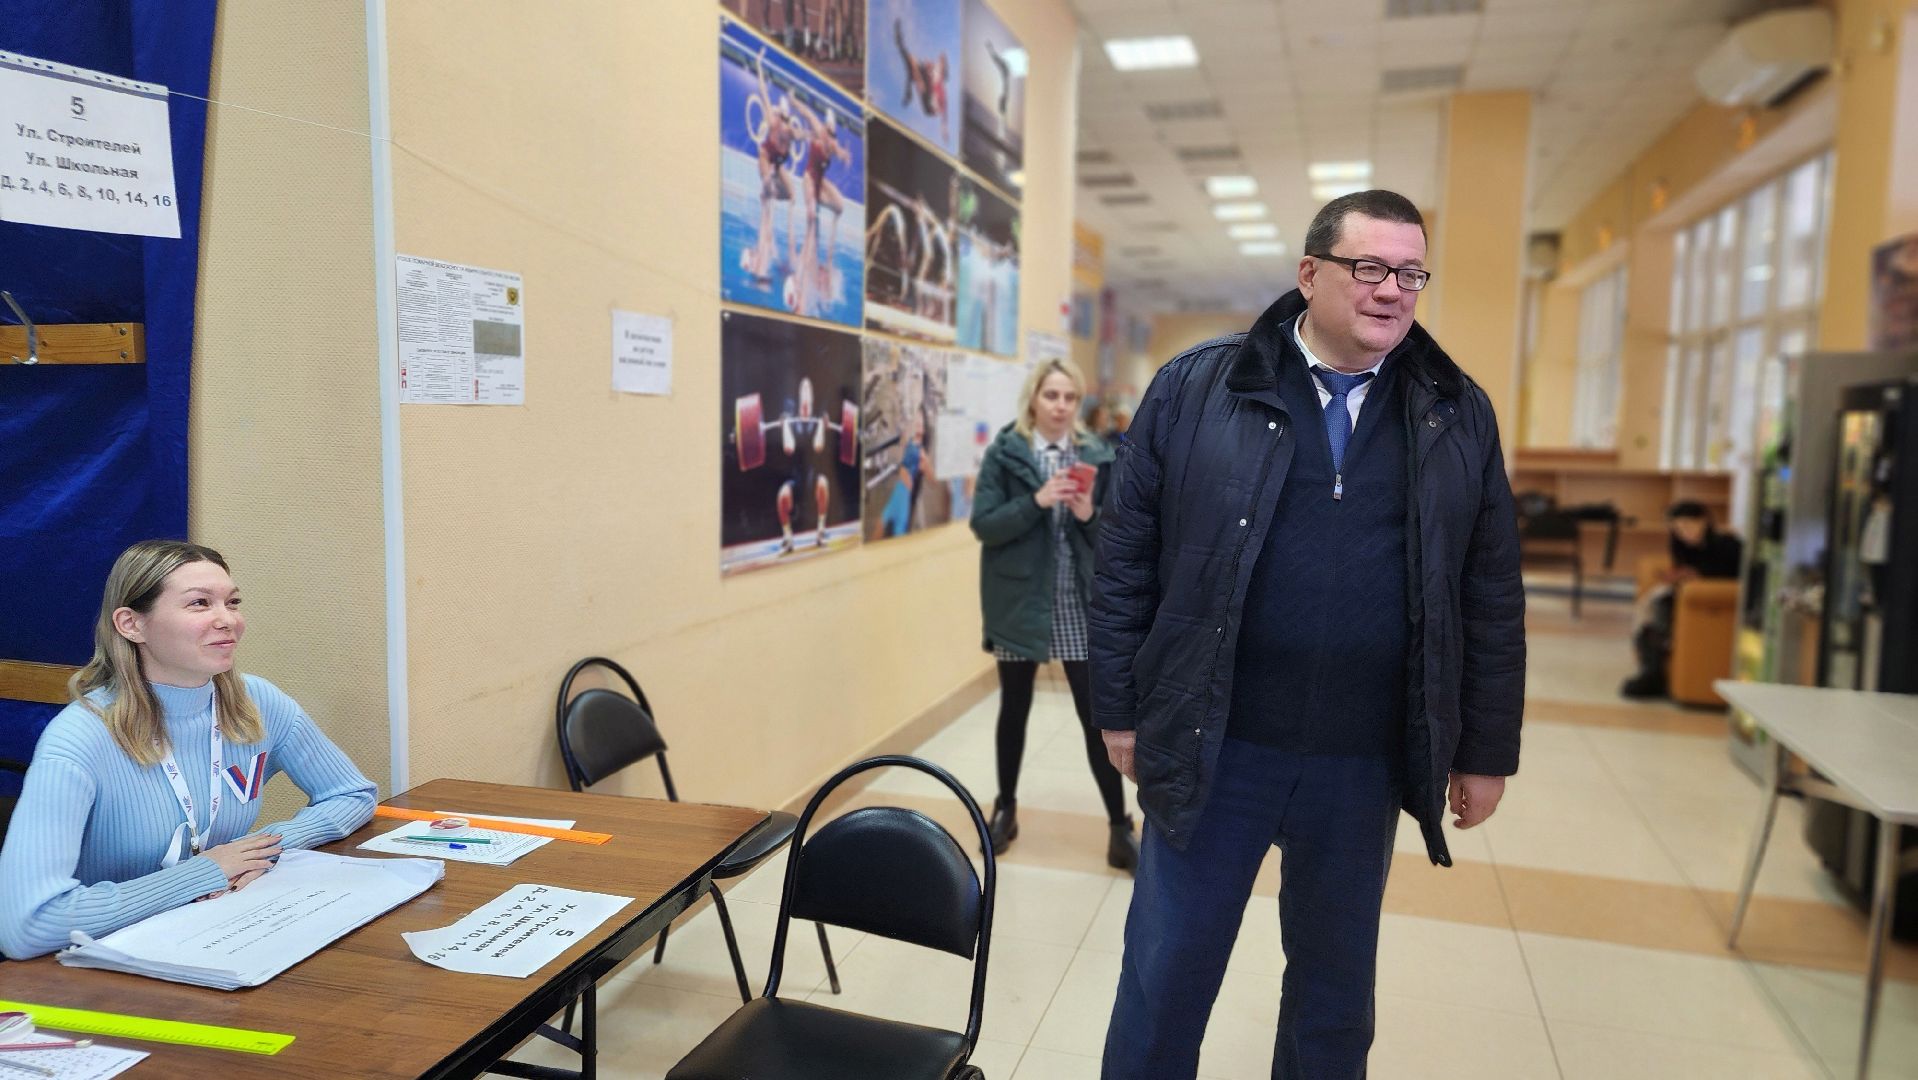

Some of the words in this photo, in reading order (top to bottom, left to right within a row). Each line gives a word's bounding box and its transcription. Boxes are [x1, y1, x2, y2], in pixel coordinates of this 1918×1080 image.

[71, 95, 86, 116] 5
[15, 122, 42, 140] Ул.
[46, 128, 142, 155] Строителей
[25, 151, 50, 167] Ул.
[55, 155, 139, 179] Школьная
[20, 177, 36, 192] 2,
[39, 180, 53, 197] 4,
[57, 182, 73, 199] 6,
[77, 185, 92, 201] 8,
[96, 187, 121, 204] 10,
[125, 191, 148, 207] 14,
[152, 194, 172, 207] 16
[518, 895, 537, 903] 2,
[494, 911, 512, 919] 6,
[529, 903, 553, 915] Ул.
[554, 903, 578, 915] Ул.
[462, 928, 487, 940] 10,
[472, 915, 535, 953] Школьная
[490, 915, 560, 958] Строителей
[555, 928, 575, 937] 5
[441, 941, 467, 951] 14,
[427, 952, 446, 961] 16
